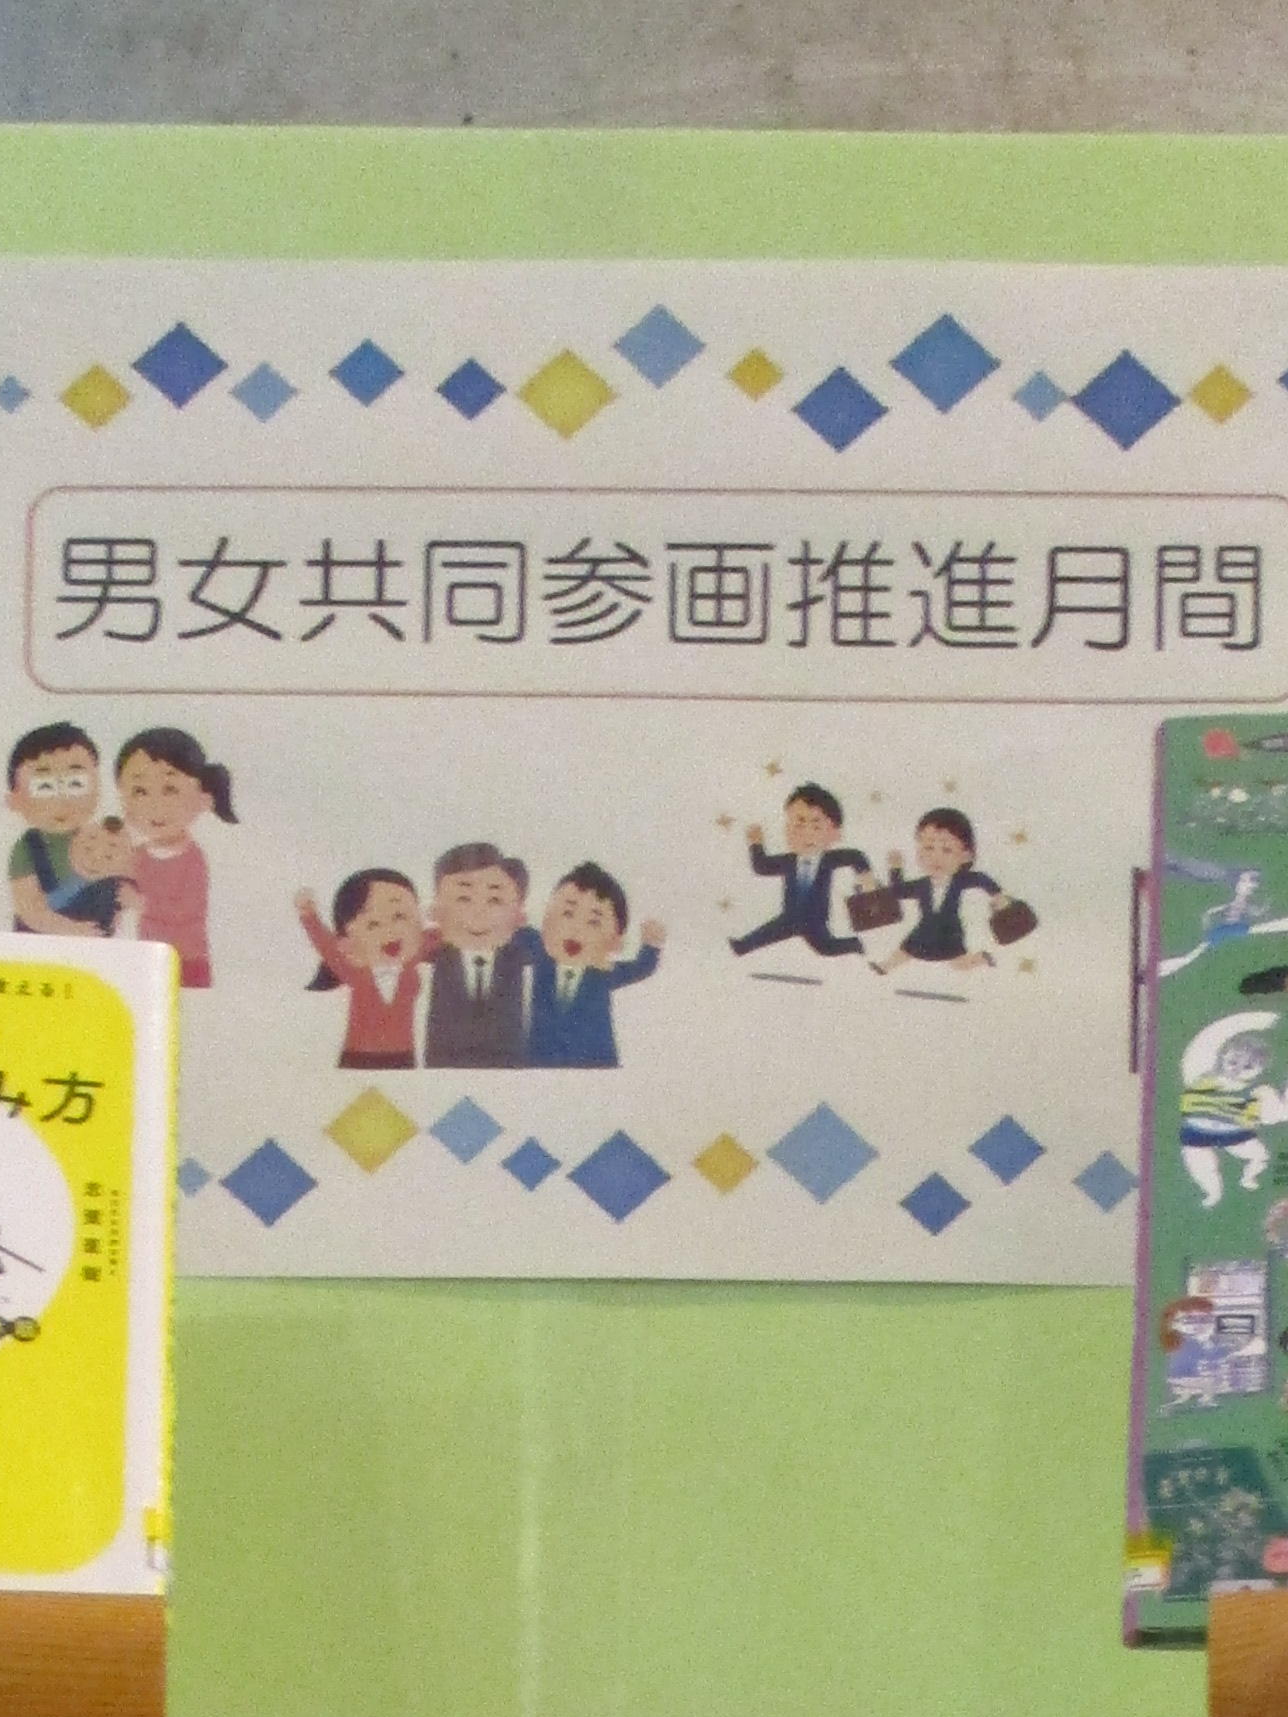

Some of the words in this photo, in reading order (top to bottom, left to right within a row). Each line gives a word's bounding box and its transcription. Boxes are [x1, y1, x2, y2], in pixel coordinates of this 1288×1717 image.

[55, 536, 1265, 654] 男女共同参画推進月間
